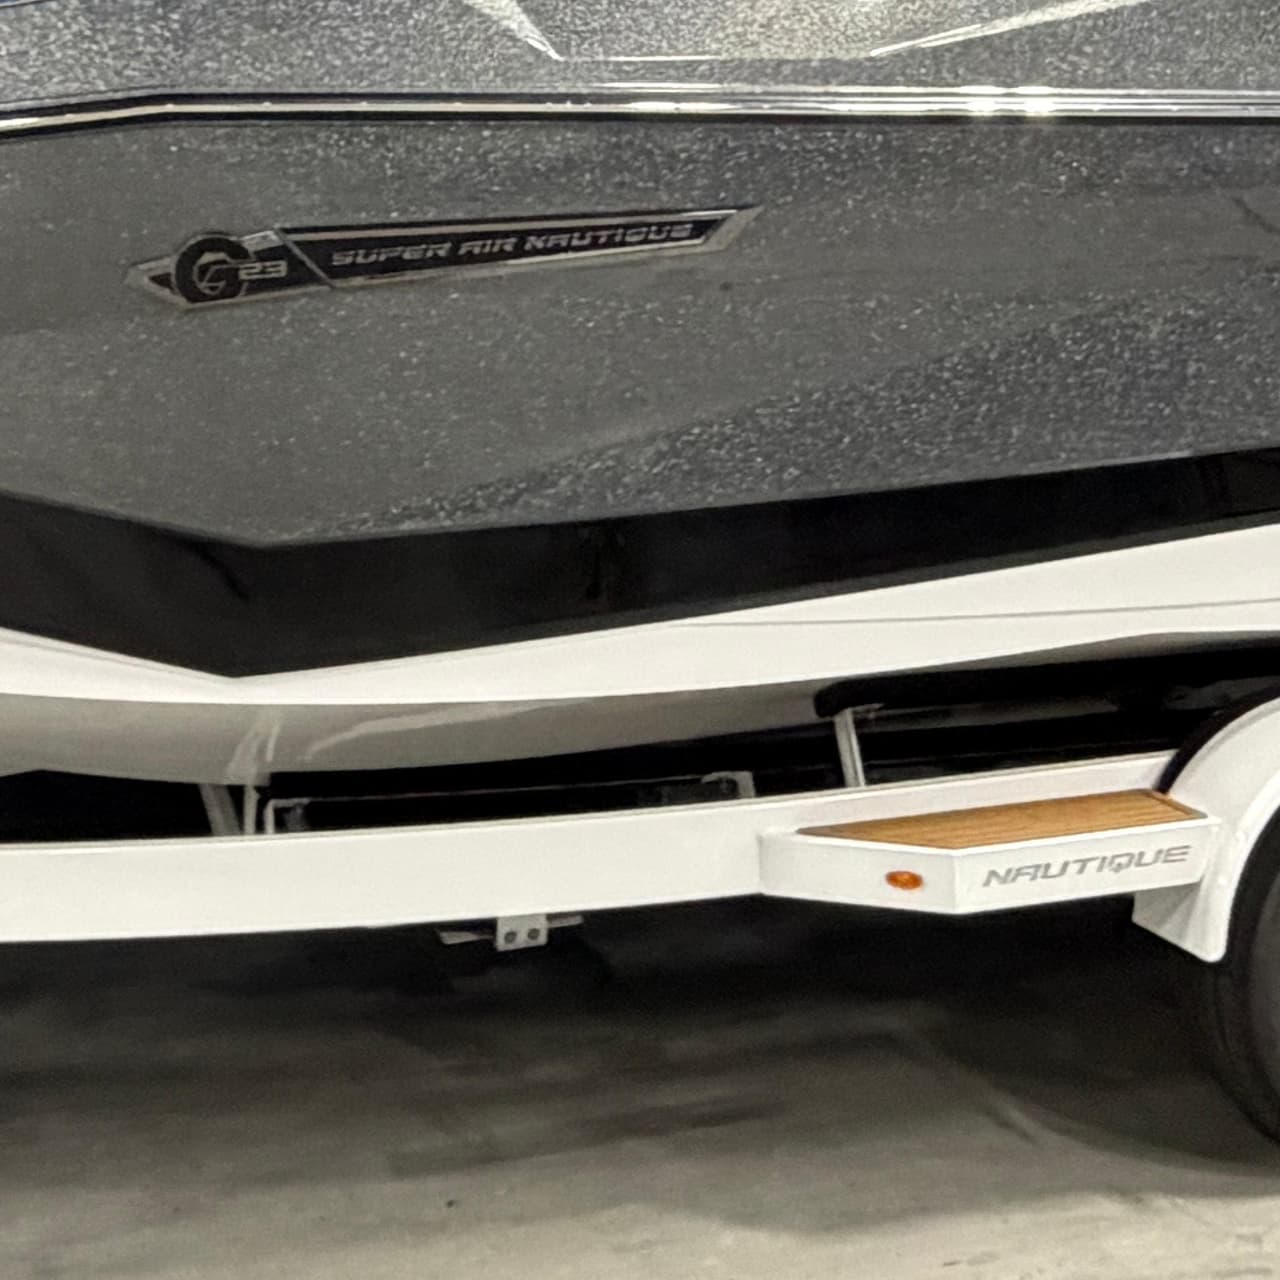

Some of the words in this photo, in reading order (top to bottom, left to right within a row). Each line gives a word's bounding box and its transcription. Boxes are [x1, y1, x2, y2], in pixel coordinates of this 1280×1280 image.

[332, 242, 451, 267] SUPER
[457, 237, 519, 256] AIR
[524, 223, 694, 252] NAUTIQUE
[982, 845, 1193, 888] NAUTIQUE
